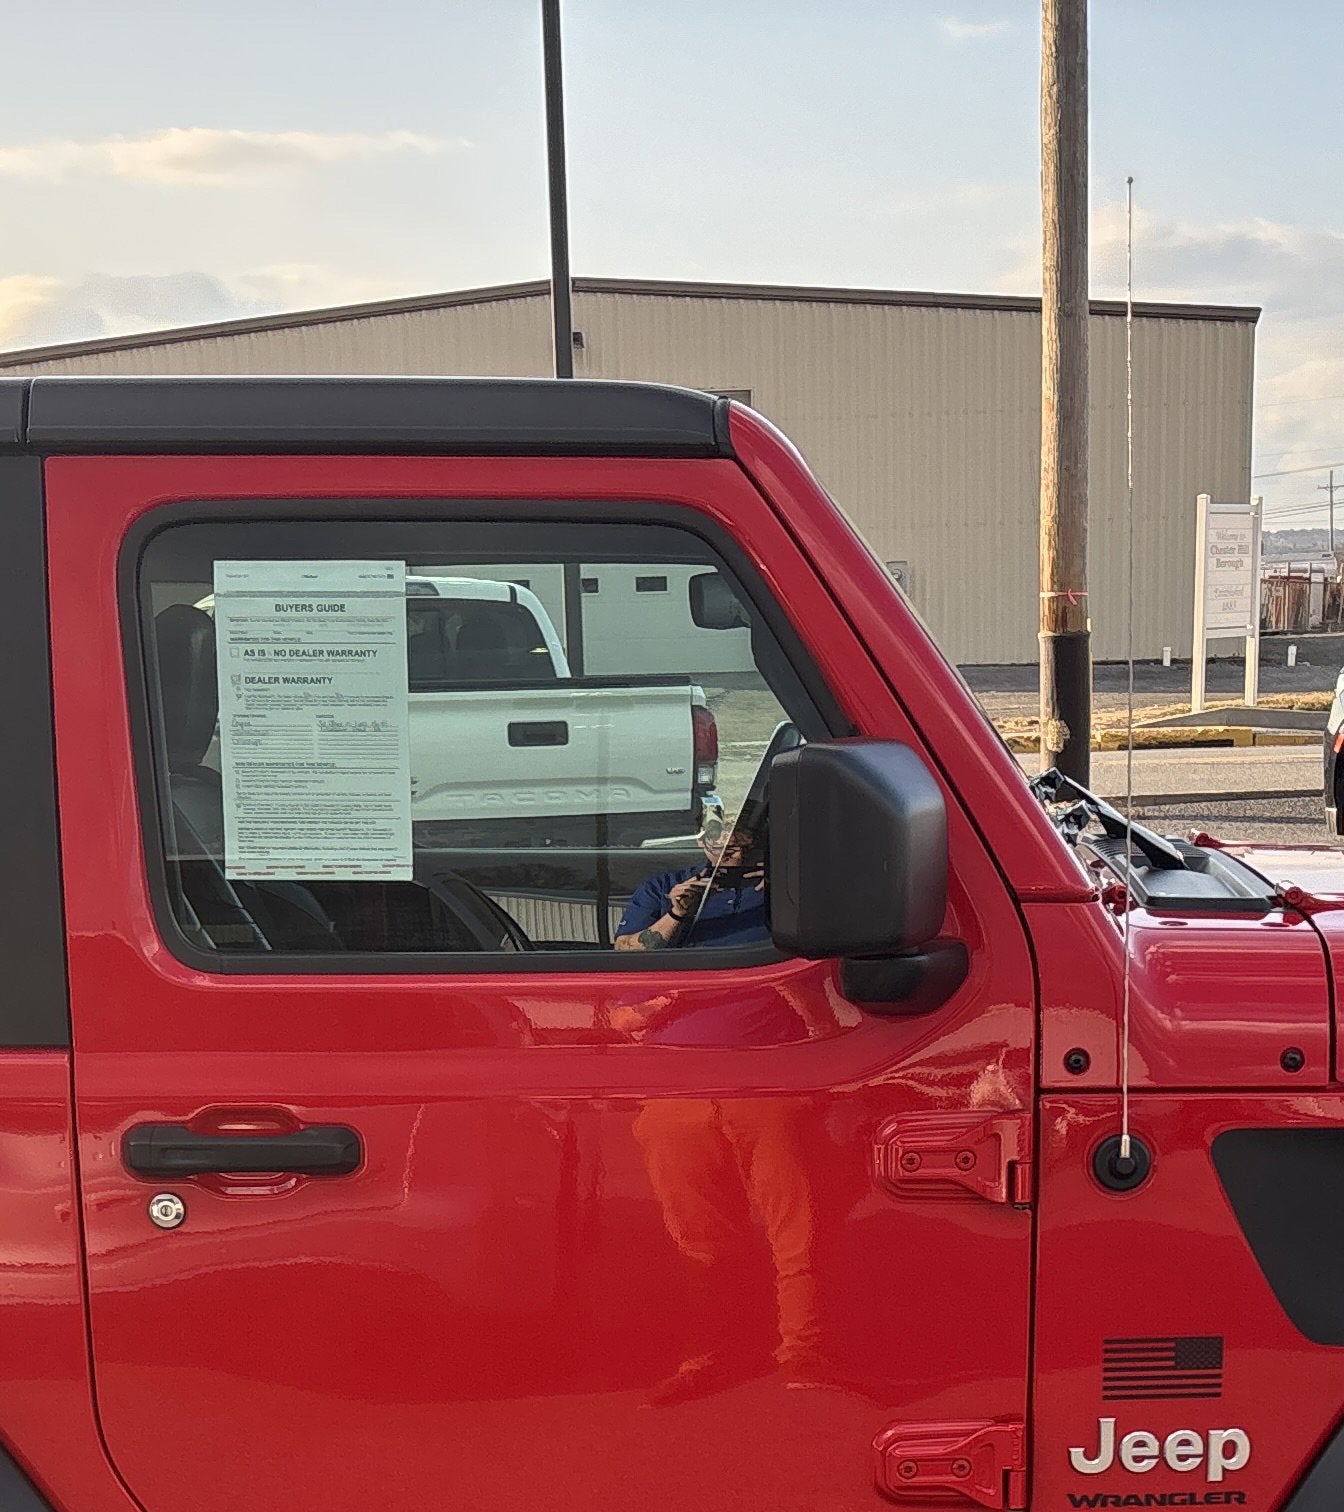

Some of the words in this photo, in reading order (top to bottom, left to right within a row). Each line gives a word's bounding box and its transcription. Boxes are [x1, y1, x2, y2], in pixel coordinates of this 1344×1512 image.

[274, 603, 314, 613] BUYERS
[316, 603, 346, 613] GUIDE
[243, 649, 256, 658] AS
[257, 649, 266, 658] IS
[273, 649, 287, 658] NO
[289, 649, 325, 658] DEALER
[326, 649, 378, 658] WARRANTY
[244, 676, 280, 685] DEALER
[282, 676, 333, 685] WARRANTY
[445, 787, 632, 807] TACOMA
[1067, 1416, 1252, 1483] Jeep
[1066, 1490, 1248, 1509] WRANGLER
